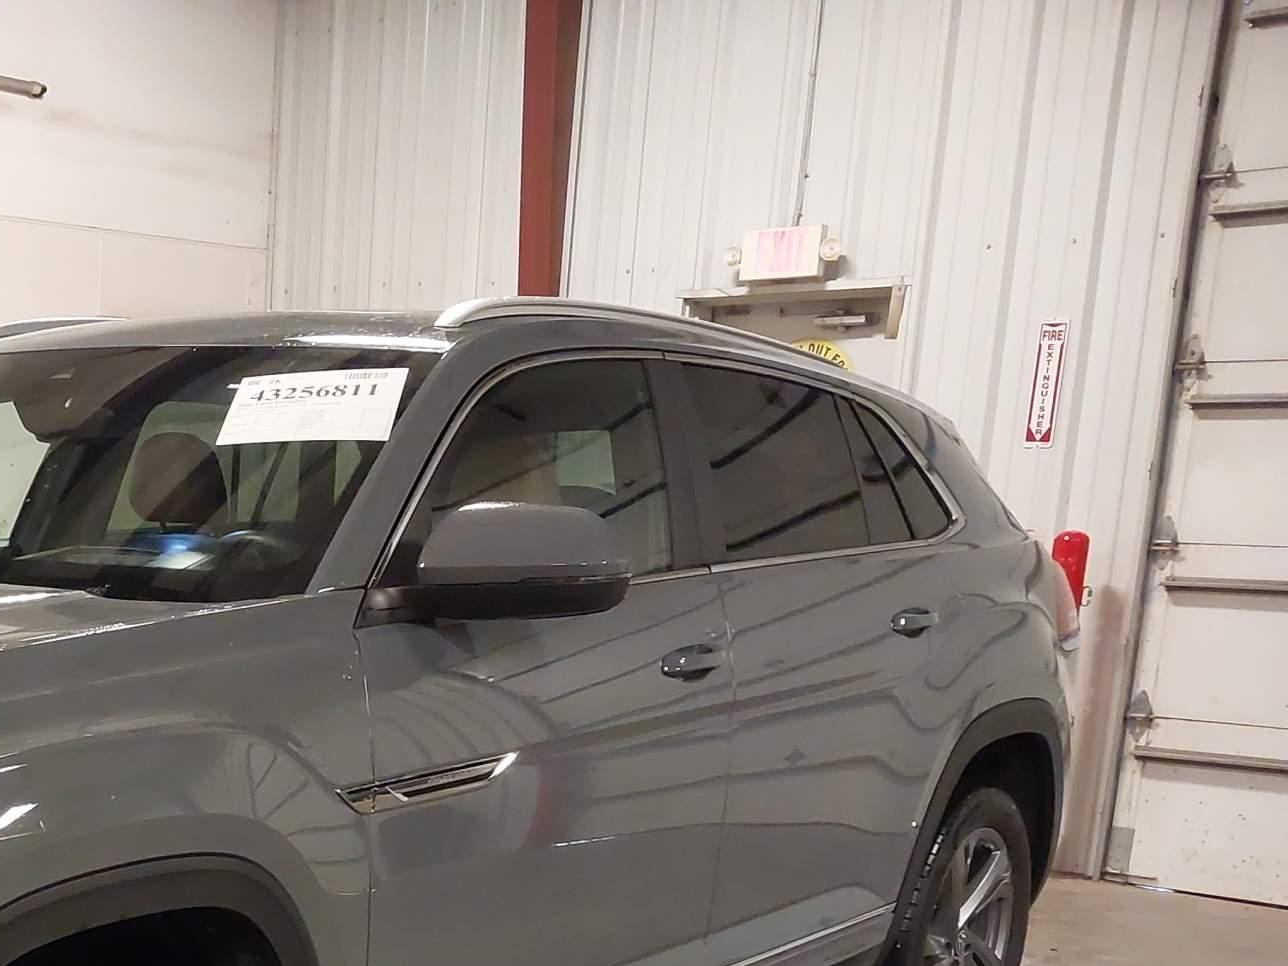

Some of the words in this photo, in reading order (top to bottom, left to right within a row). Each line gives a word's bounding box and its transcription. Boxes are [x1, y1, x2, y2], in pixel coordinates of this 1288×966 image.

[1042, 330, 1064, 341] FIRE
[831, 353, 846, 367] FO
[250, 382, 378, 402] 43256811
[1035, 343, 1055, 435] EXTINGUISHER
